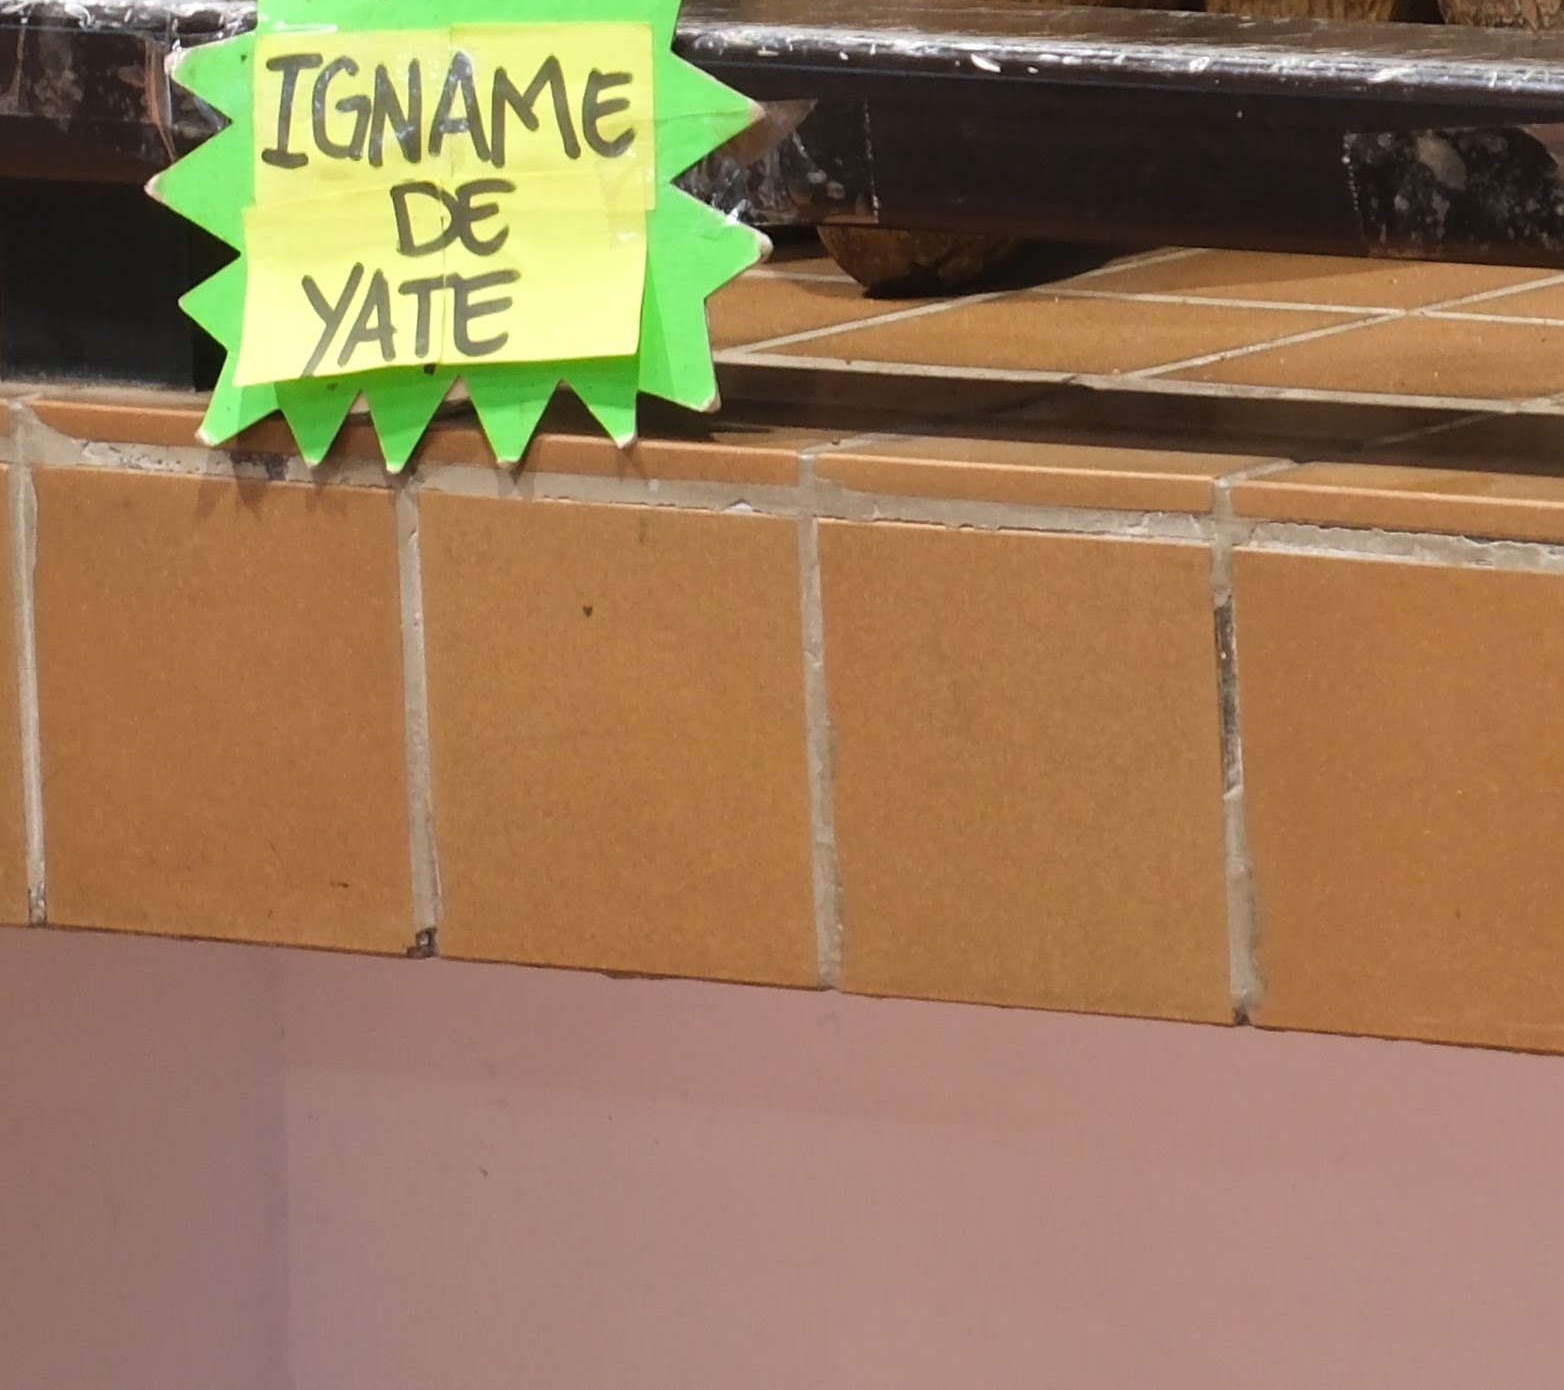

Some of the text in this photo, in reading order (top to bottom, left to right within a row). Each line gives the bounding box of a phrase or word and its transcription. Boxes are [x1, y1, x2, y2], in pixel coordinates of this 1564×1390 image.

[261, 51, 636, 169] IGNAME
[389, 177, 517, 257] DE
[300, 261, 521, 378] YATE
